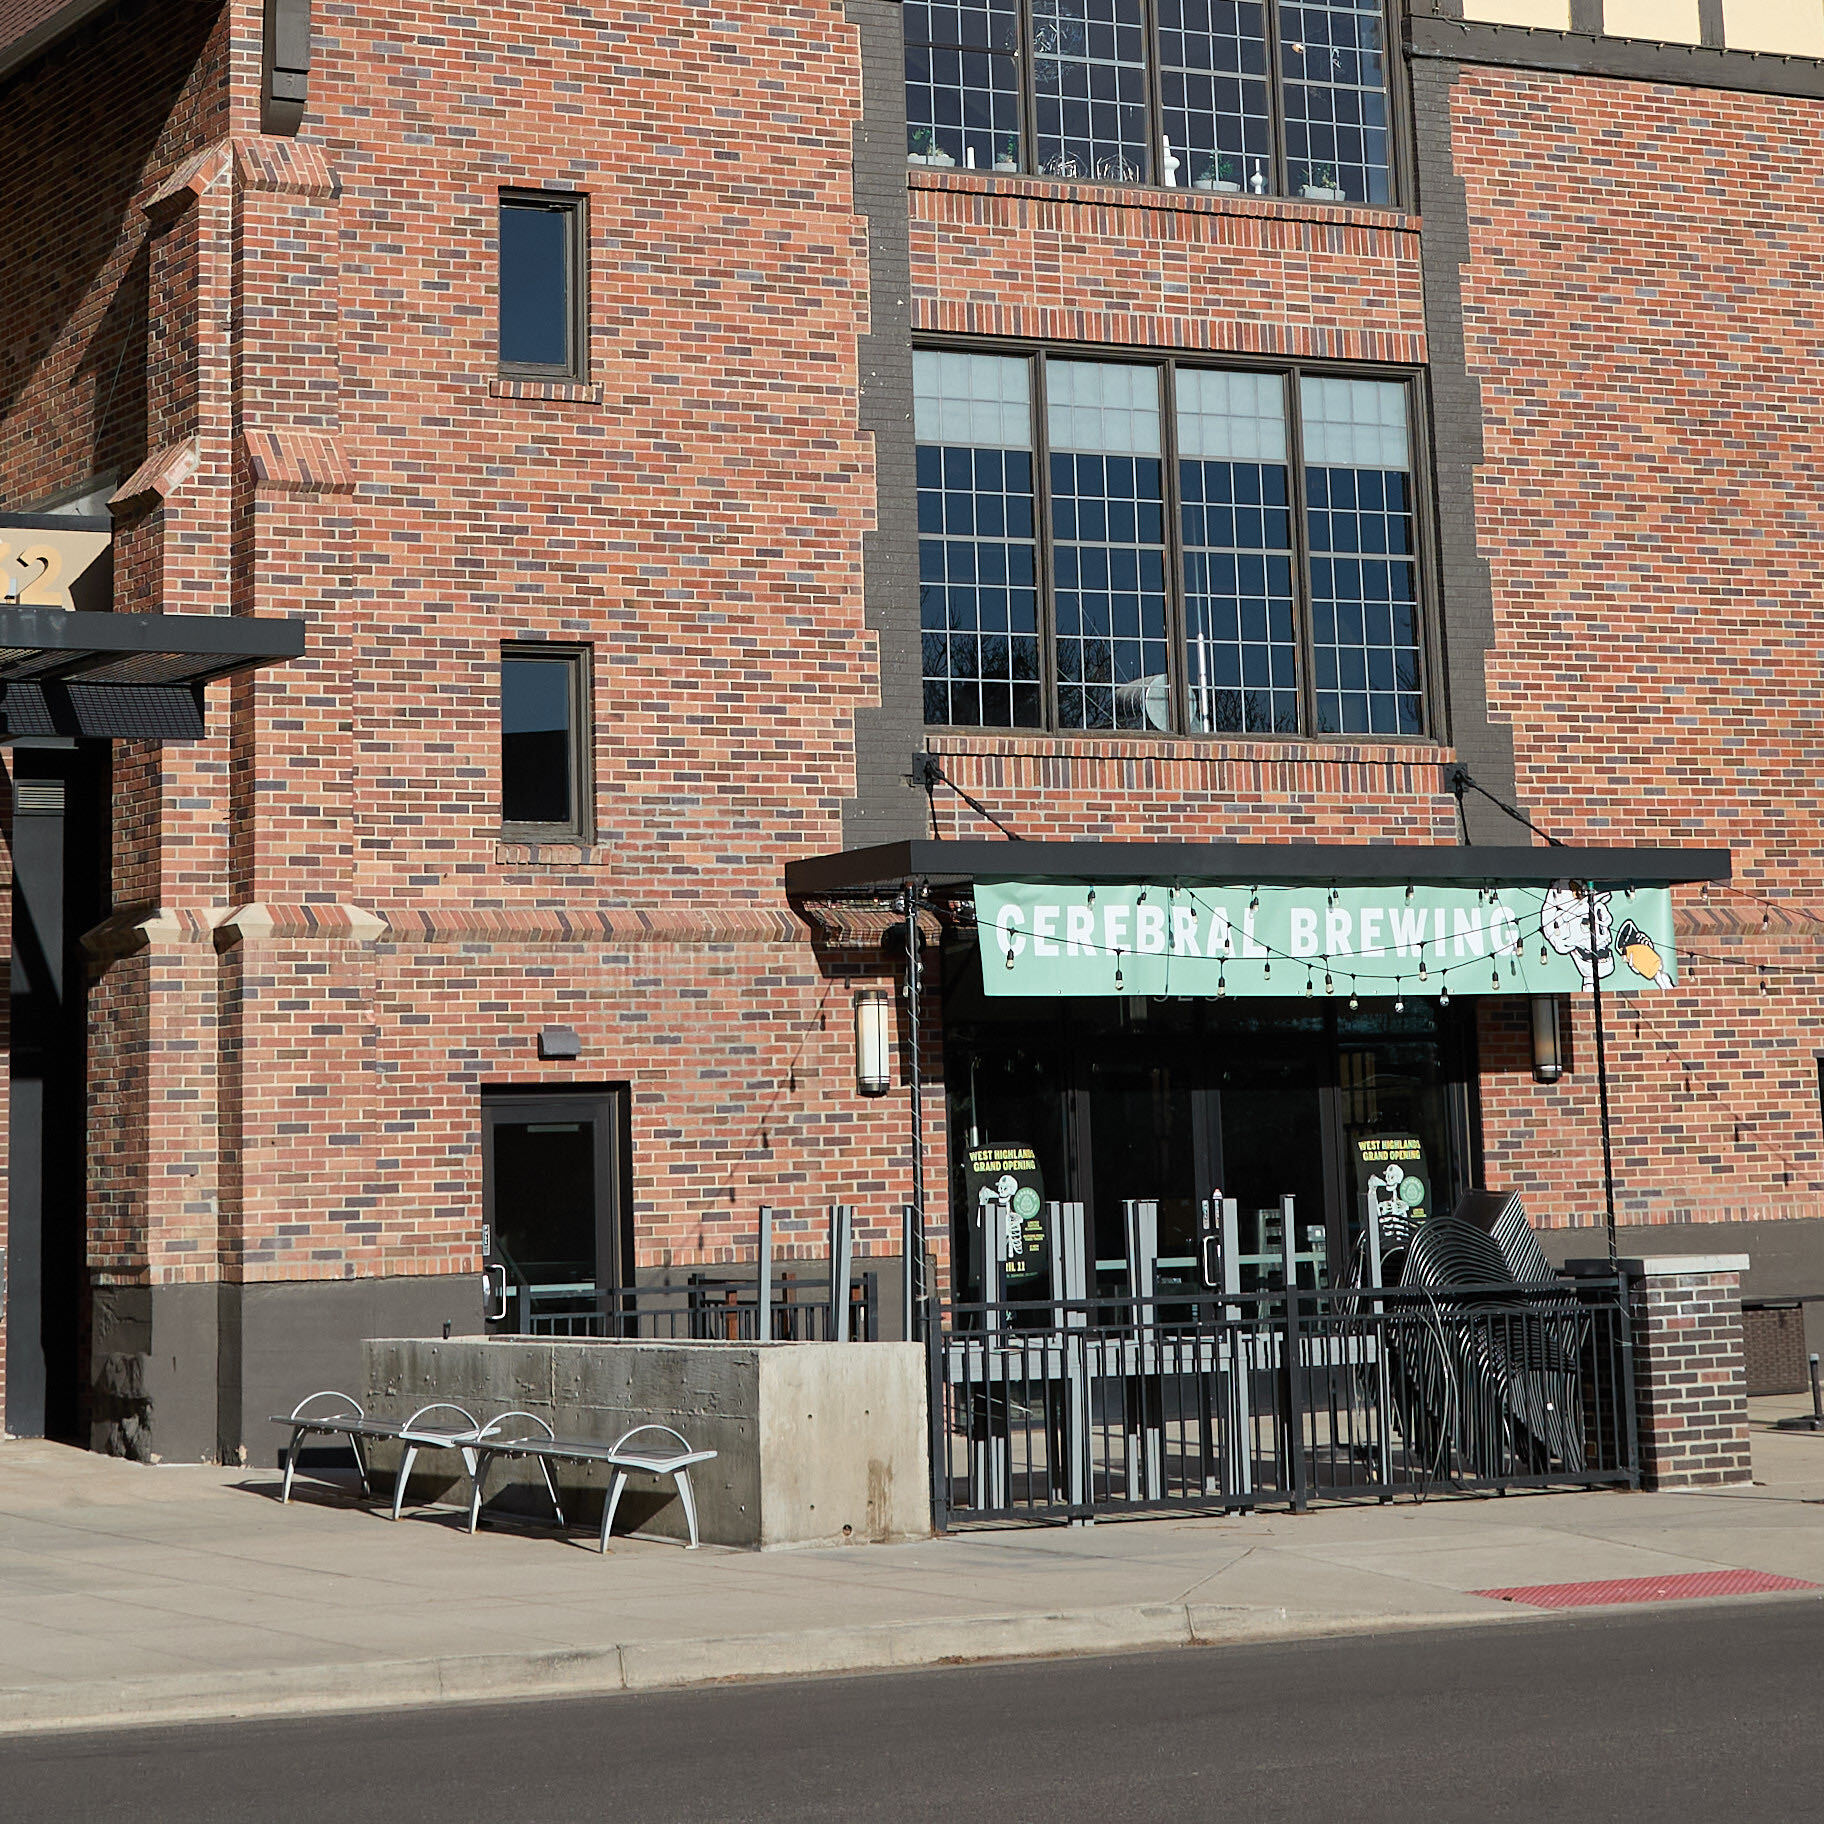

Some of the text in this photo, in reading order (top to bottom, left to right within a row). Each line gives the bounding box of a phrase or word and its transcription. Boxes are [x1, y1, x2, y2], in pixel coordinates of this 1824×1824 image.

[995, 903, 1520, 959] CEREBRAL BREWING
[1358, 1140, 1380, 1151] WEST
[969, 1150, 993, 1161] WEST
[1362, 1149, 1421, 1161] GRAND OPENING
[973, 1160, 1036, 1172] GRAND OPENING
